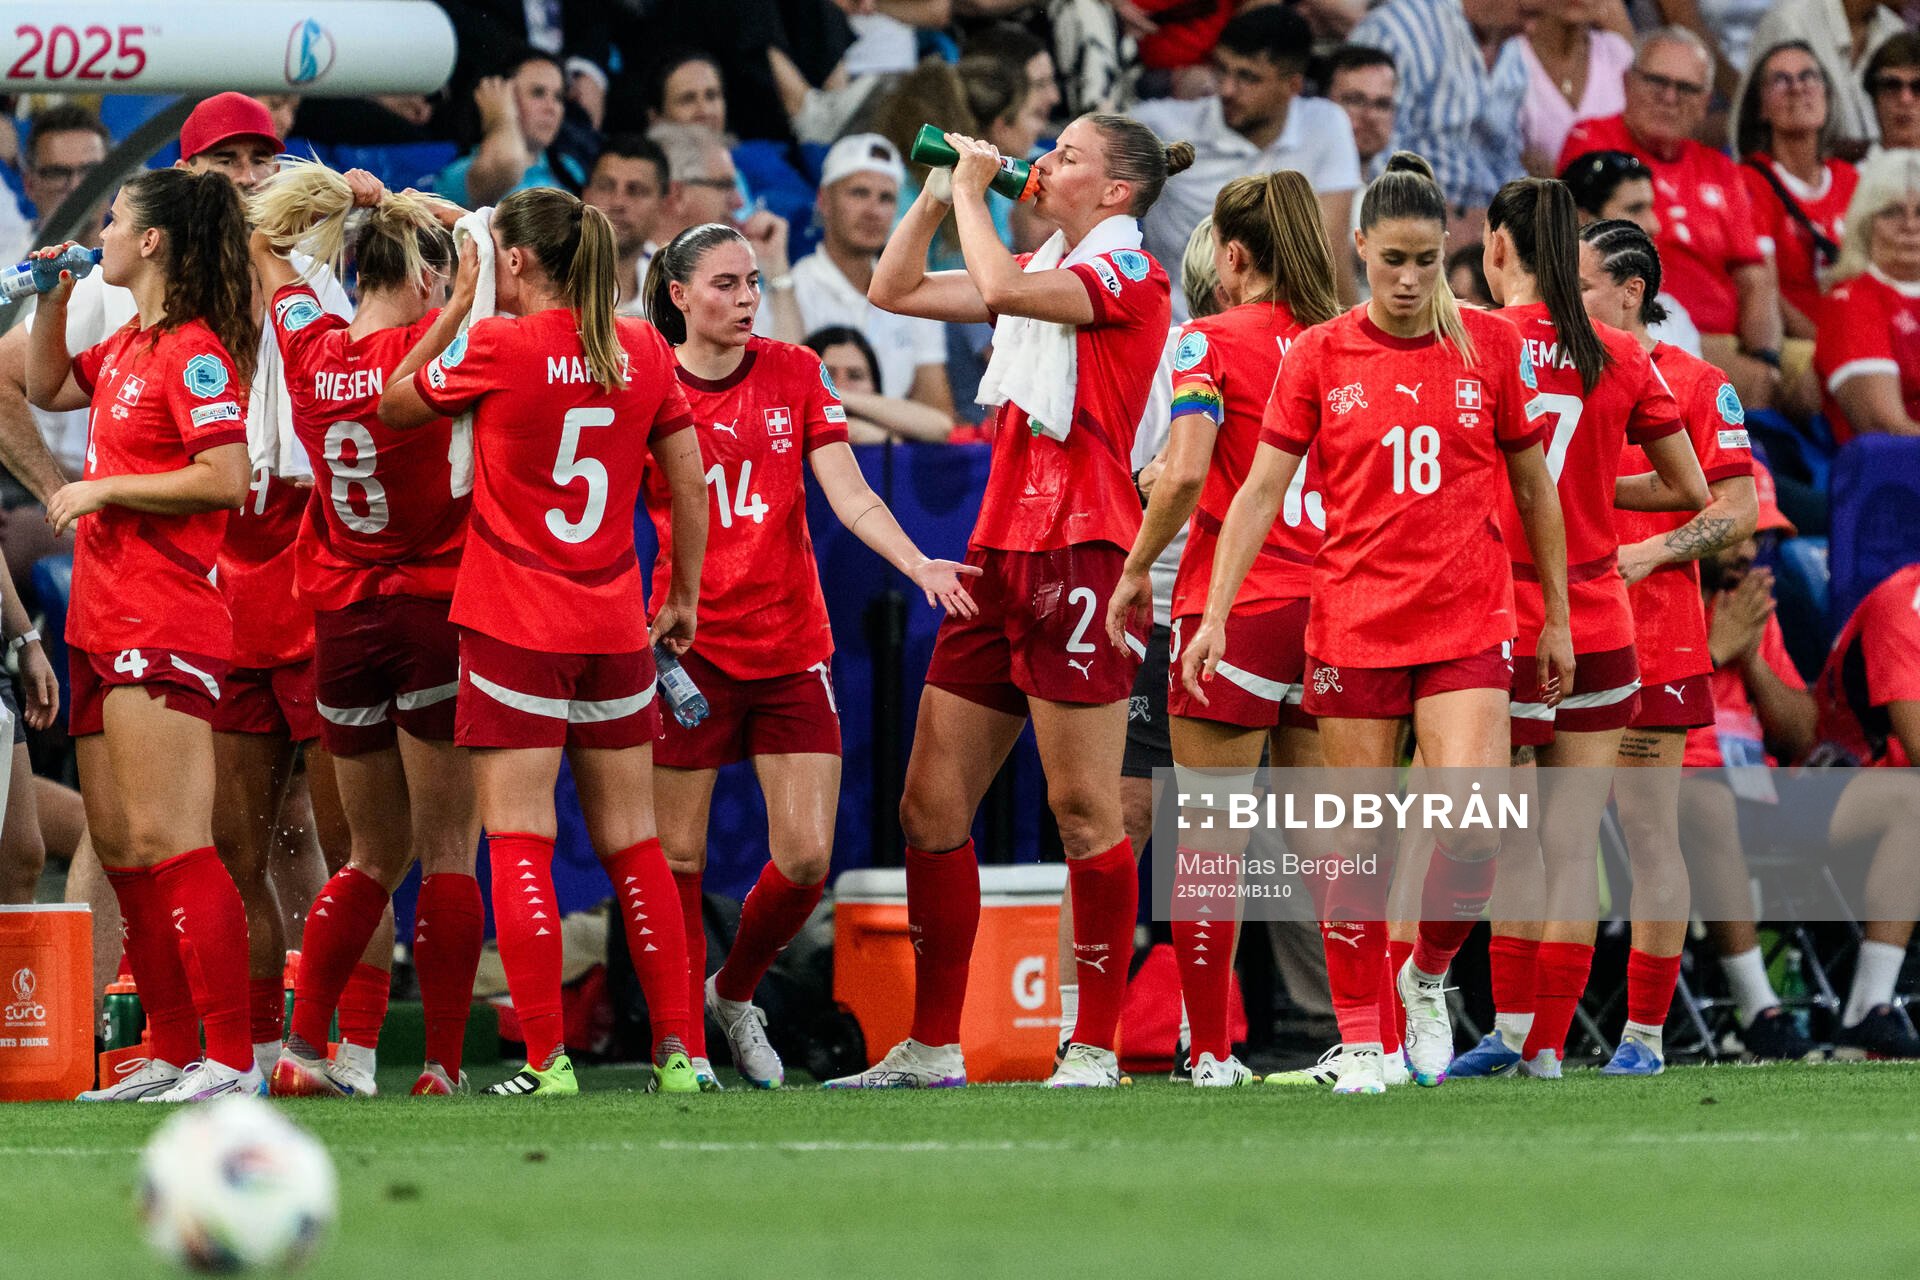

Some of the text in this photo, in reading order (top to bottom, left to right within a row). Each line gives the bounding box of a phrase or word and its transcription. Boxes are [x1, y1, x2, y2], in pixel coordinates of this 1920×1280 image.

[6, 24, 147, 80] 2025
[315, 367, 383, 401] RIESEN
[1381, 425, 1442, 495] 18
[1538, 392, 1584, 486] 7
[323, 420, 389, 534] 8
[544, 407, 616, 544] 5
[704, 460, 769, 528] 14
[1065, 586, 1097, 653] 2
[114, 648, 148, 678] 4
[1011, 956, 1046, 1010] G
[20, 1037, 49, 1048] DRINK
